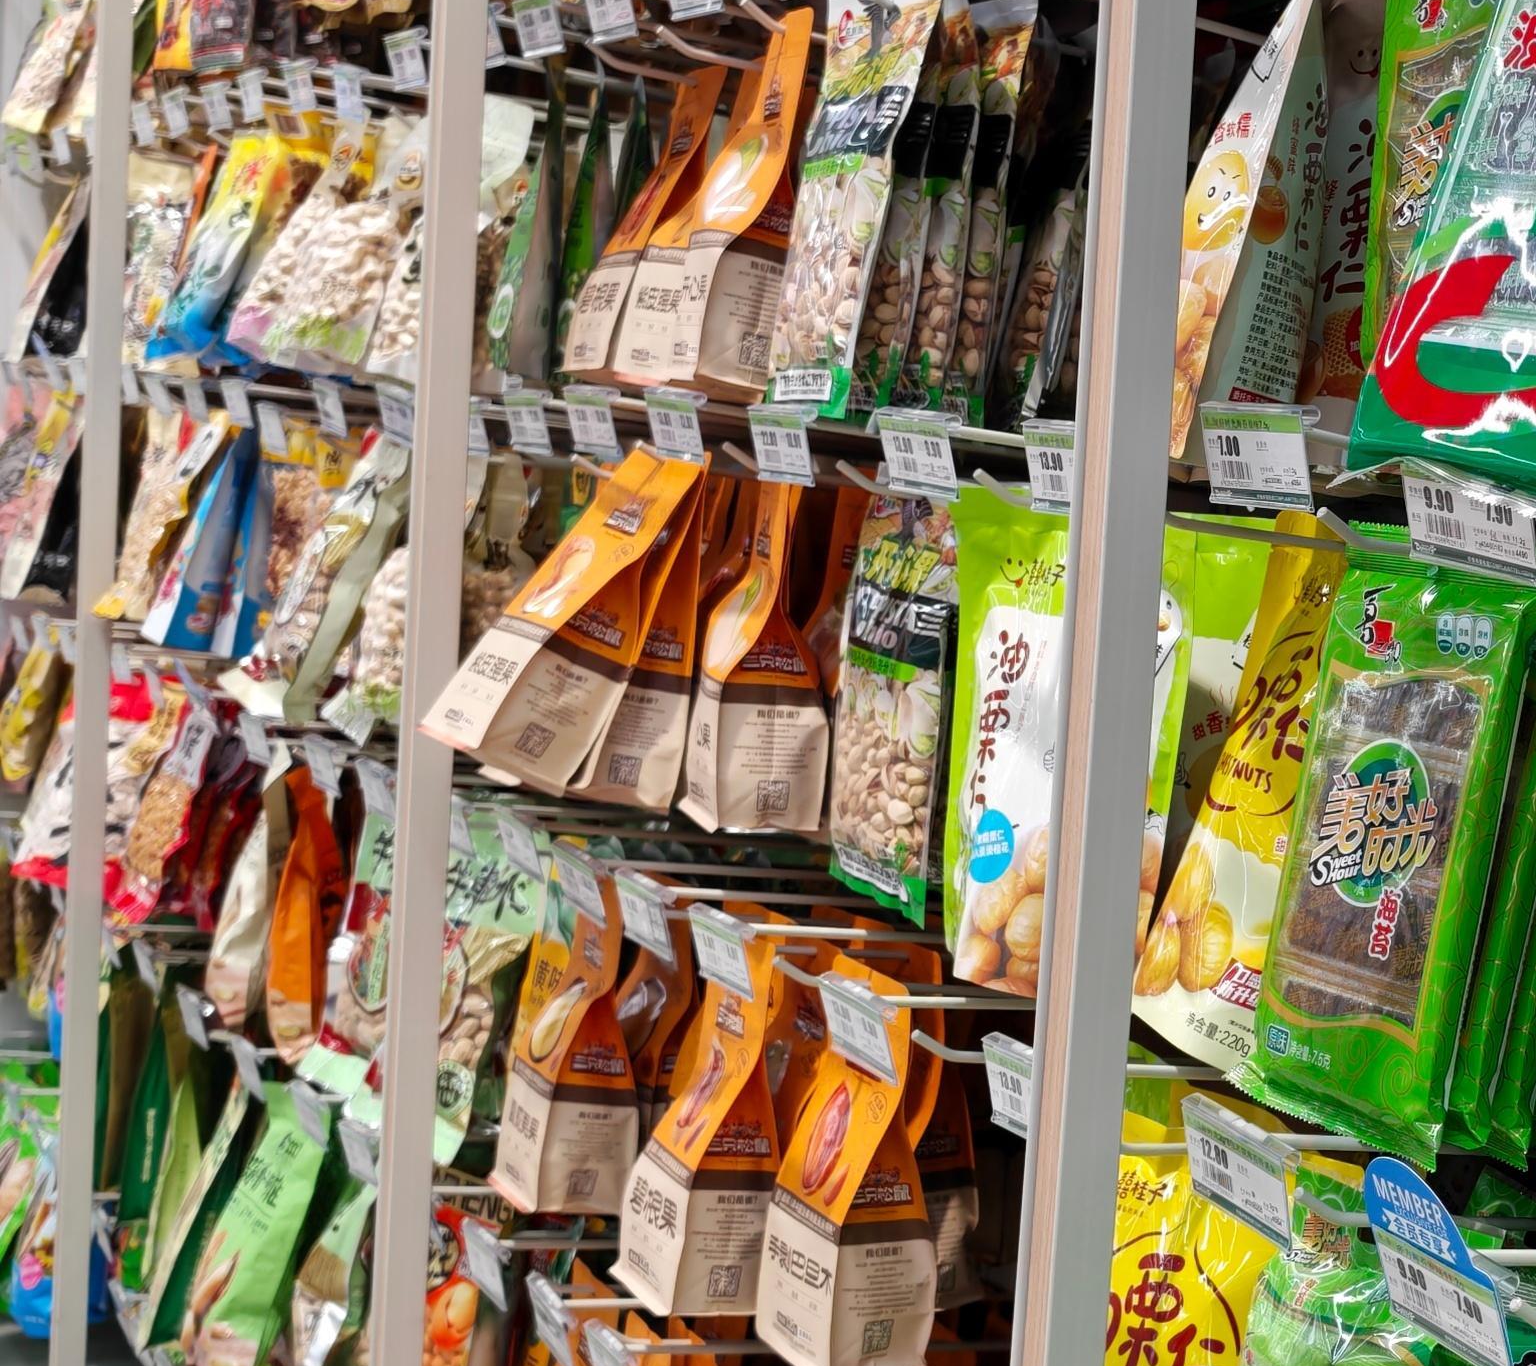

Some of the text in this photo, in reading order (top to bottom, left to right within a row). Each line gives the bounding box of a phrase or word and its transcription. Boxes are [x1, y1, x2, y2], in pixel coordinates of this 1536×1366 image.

[1039, 451, 1064, 474] 13.90
[1217, 435, 1240, 457] 7.00
[1422, 484, 1457, 515] 9.90
[968, 630, 1031, 810] 油栗仁
[1367, 886, 1402, 961] 海苔
[1372, 1172, 1446, 1229] MEMBER
[1393, 1215, 1445, 1256] 会员专享
[1396, 1257, 1484, 1325] 9.90 7.90
